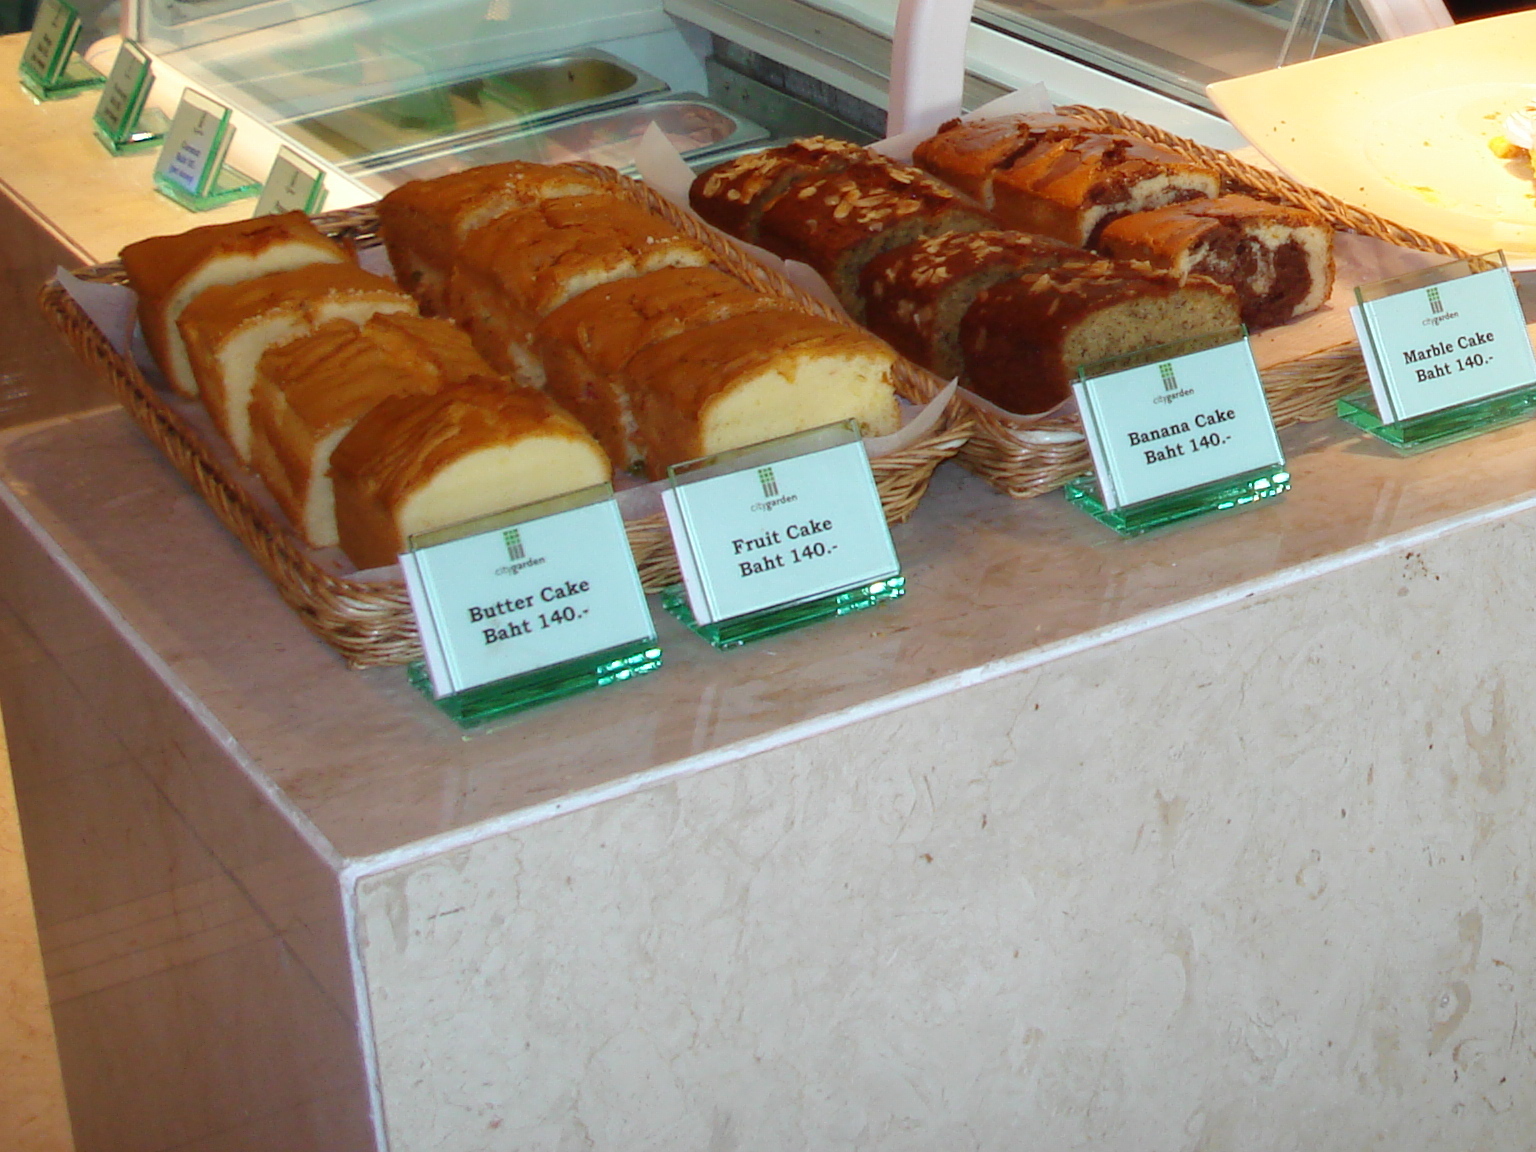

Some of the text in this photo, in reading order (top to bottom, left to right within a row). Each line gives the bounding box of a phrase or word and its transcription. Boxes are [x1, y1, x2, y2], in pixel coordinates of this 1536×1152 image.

[1422, 310, 1459, 326] citygarden
[1402, 330, 1495, 365] Marble Cake
[1415, 352, 1494, 383] Baht 140.-
[1153, 387, 1195, 405] citygarden
[1127, 408, 1236, 447] Banana Cake
[1143, 433, 1232, 465] Baht 140.-
[751, 493, 798, 513] citygarden
[732, 518, 833, 556] Fruit Cake
[495, 556, 546, 576] citygarden
[738, 541, 838, 577] Baht 140.-
[468, 579, 590, 624] Butter Cake
[483, 605, 590, 645] Baht 140.-
